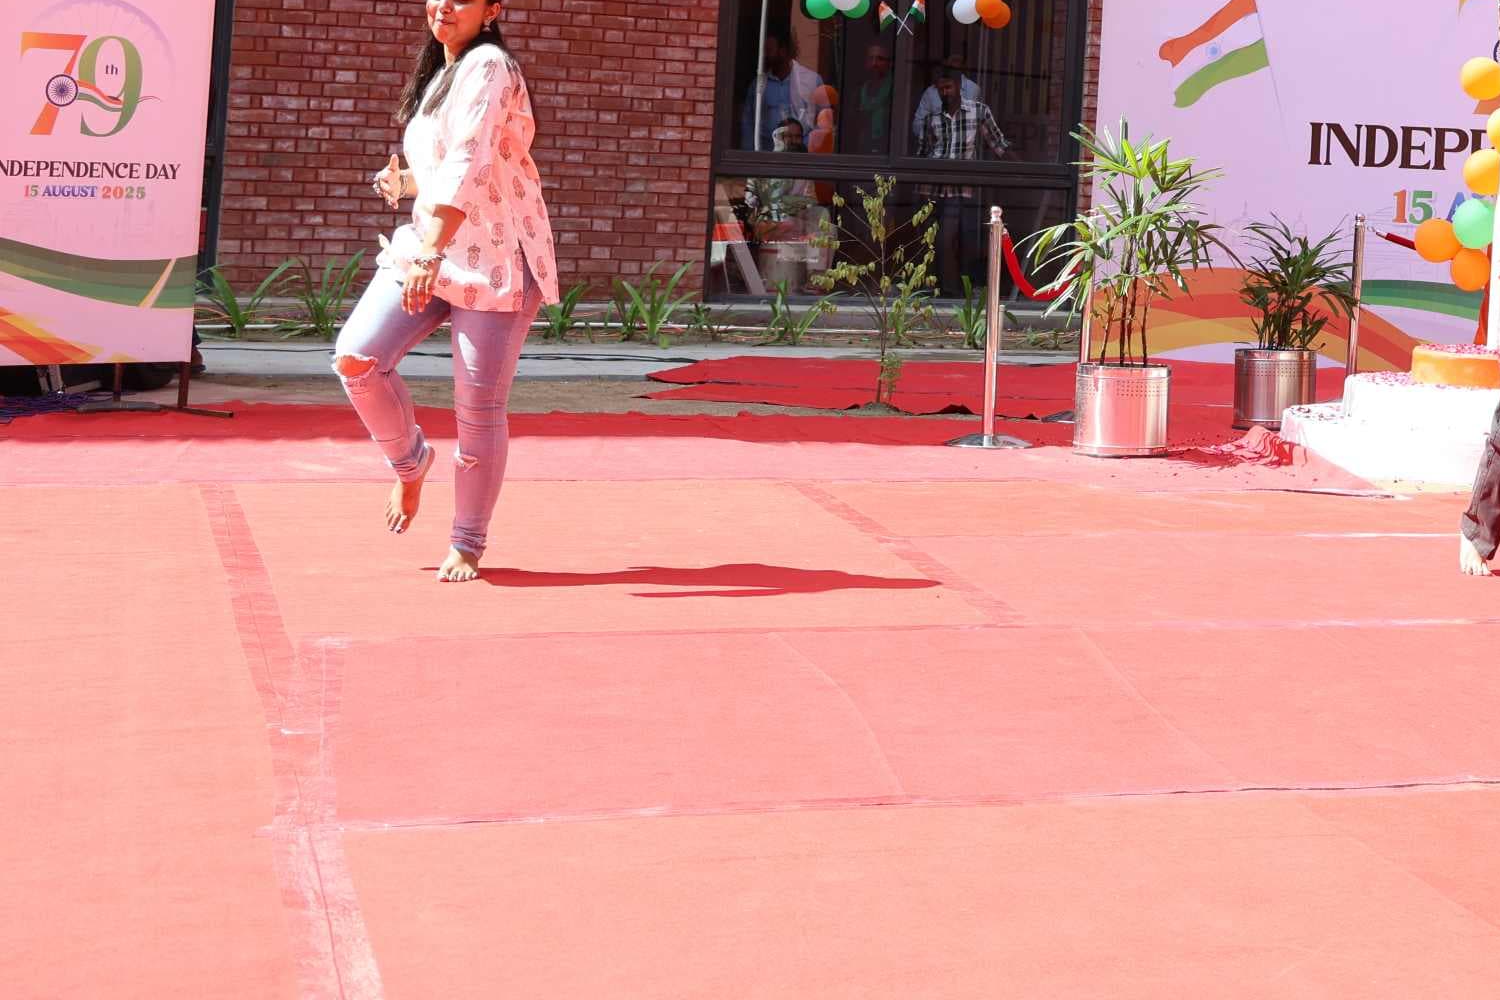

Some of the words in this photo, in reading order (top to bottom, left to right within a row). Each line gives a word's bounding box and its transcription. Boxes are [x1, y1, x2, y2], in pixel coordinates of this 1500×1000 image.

[19, 31, 143, 138] 79
[104, 63, 119, 76] th
[0, 159, 141, 180] NDEPENDENCE
[144, 162, 181, 180] DAY
[24, 184, 39, 198] 15
[42, 184, 98, 198] AUGUST
[102, 185, 146, 200] 2025
[1392, 189, 1434, 225] 15
